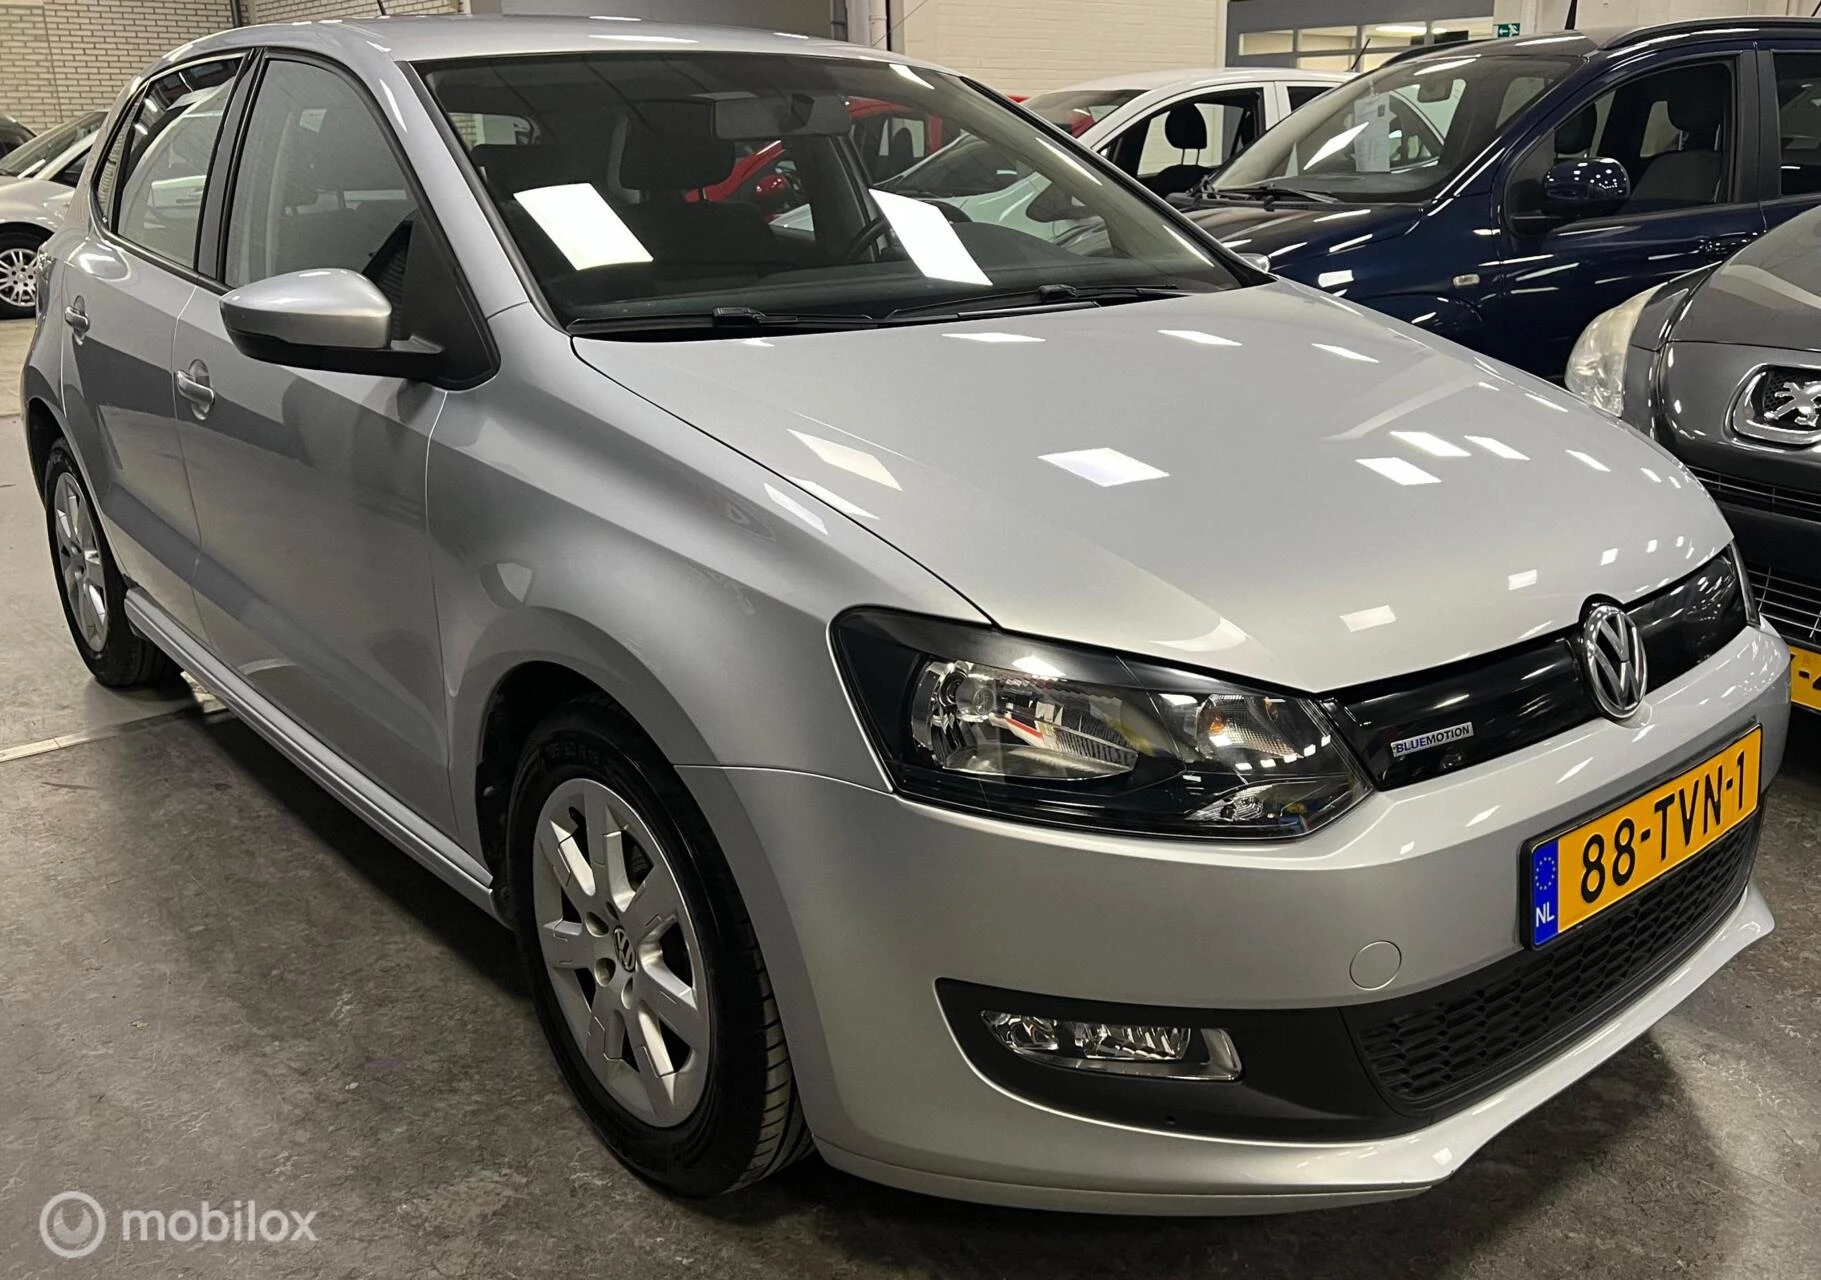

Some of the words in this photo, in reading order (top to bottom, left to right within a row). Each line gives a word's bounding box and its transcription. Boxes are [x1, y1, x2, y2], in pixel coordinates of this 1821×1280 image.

[1395, 725, 1470, 753] BLUEMOTION
[1581, 751, 1745, 904] 88-TVN-1
[1535, 902, 1555, 928] NL
